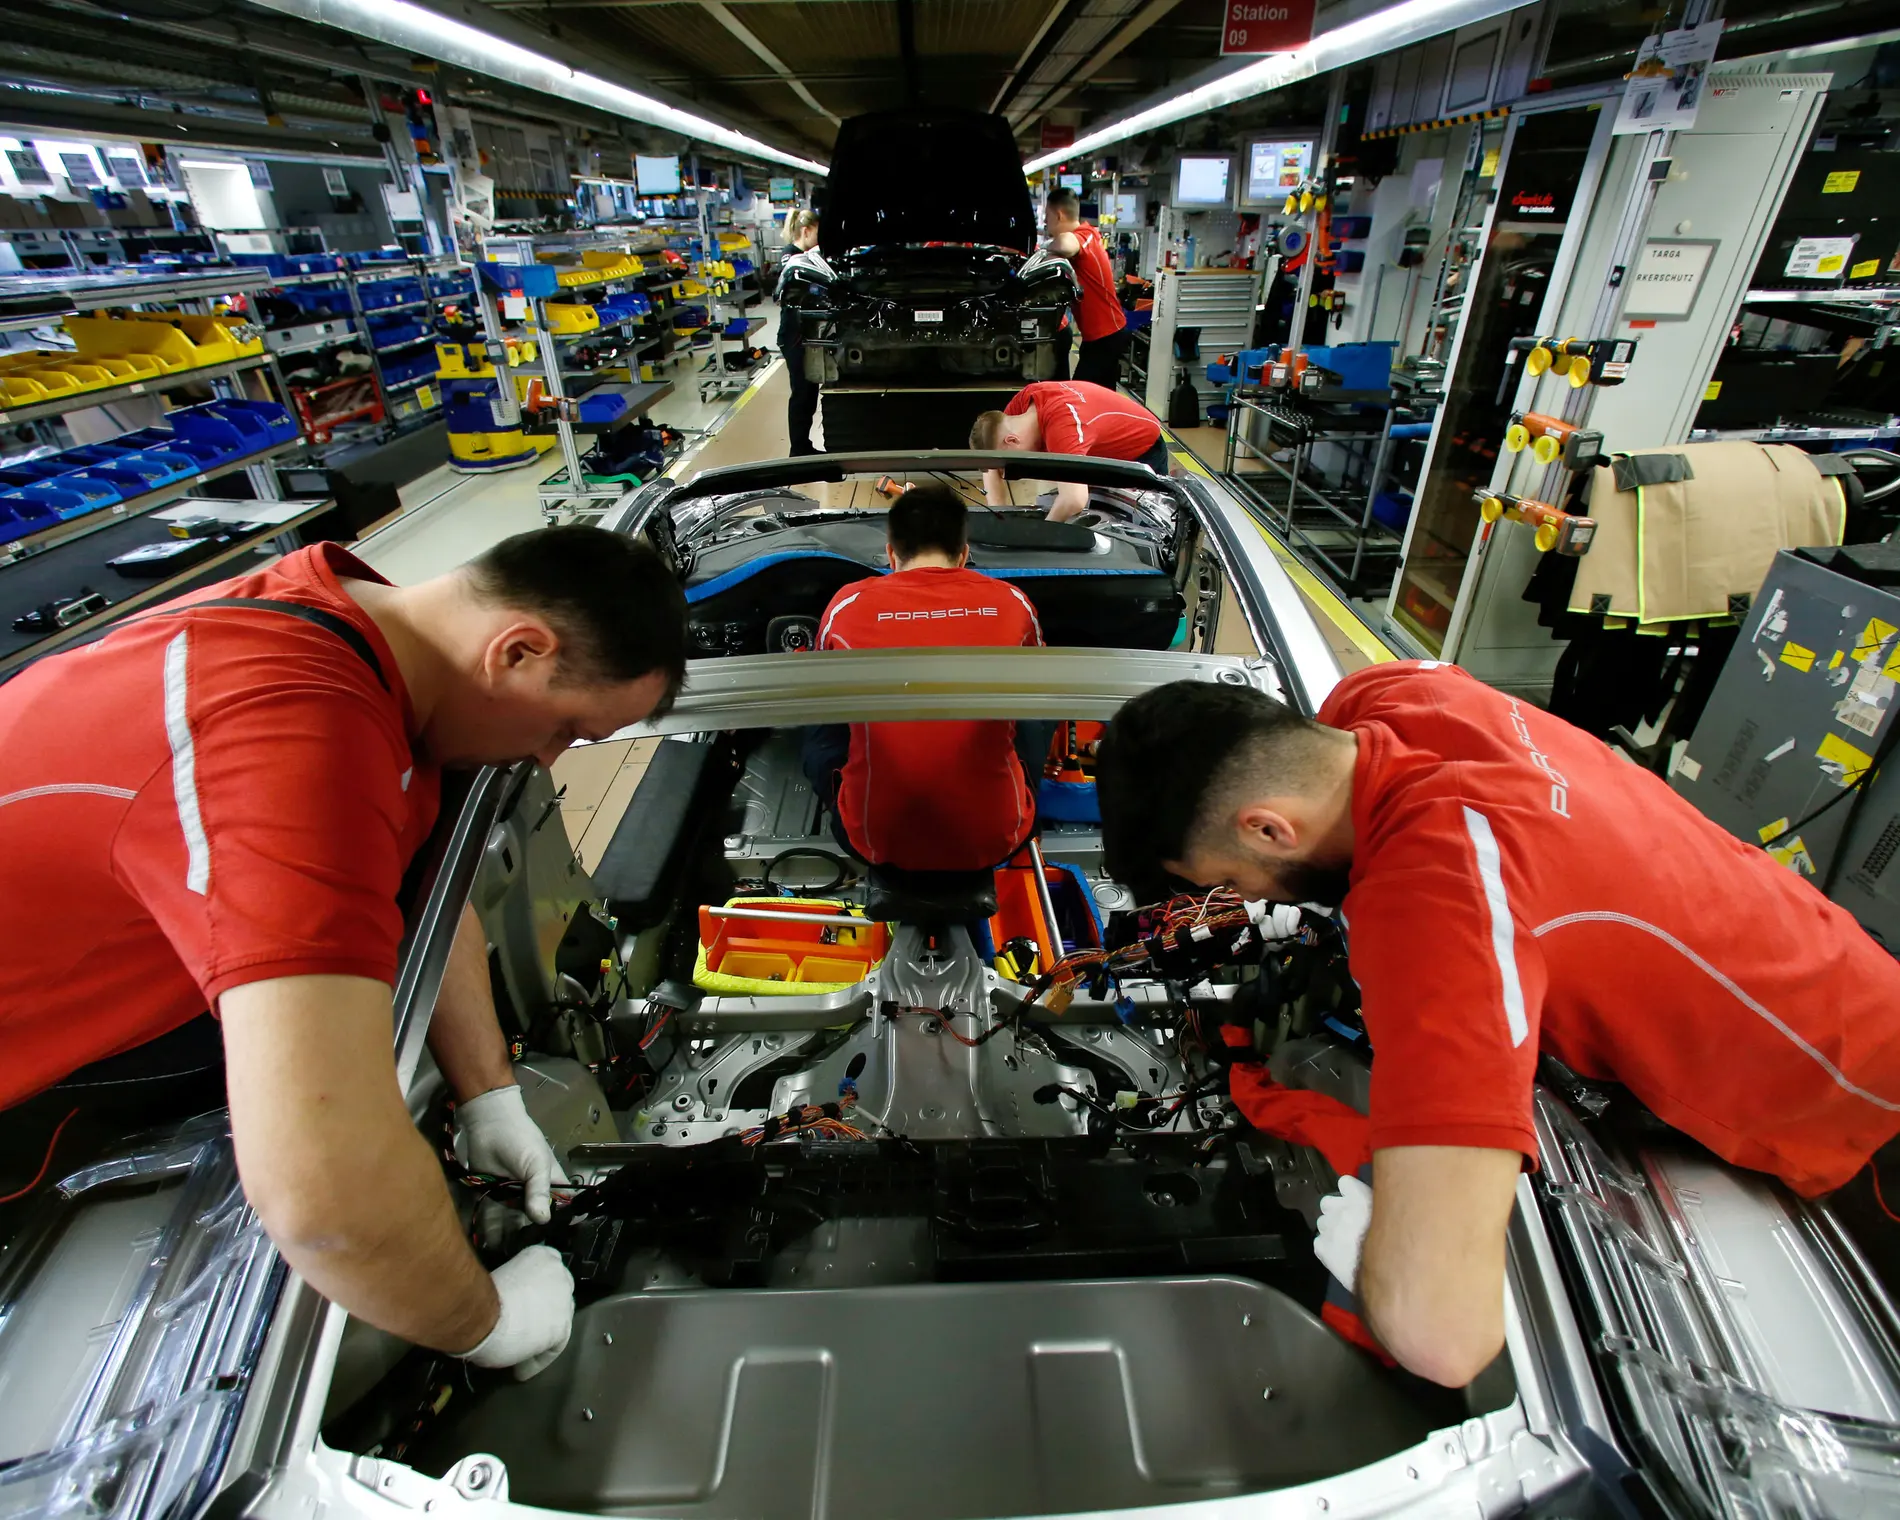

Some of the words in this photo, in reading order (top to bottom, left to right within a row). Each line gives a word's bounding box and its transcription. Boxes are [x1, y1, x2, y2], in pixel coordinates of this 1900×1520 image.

[1231, 4, 1289, 20] Station
[1228, 29, 1248, 46] 09
[1652, 250, 1681, 258] TARGA
[877, 607, 998, 621] PORSCHE
[1502, 693, 1571, 819] PORSCH
